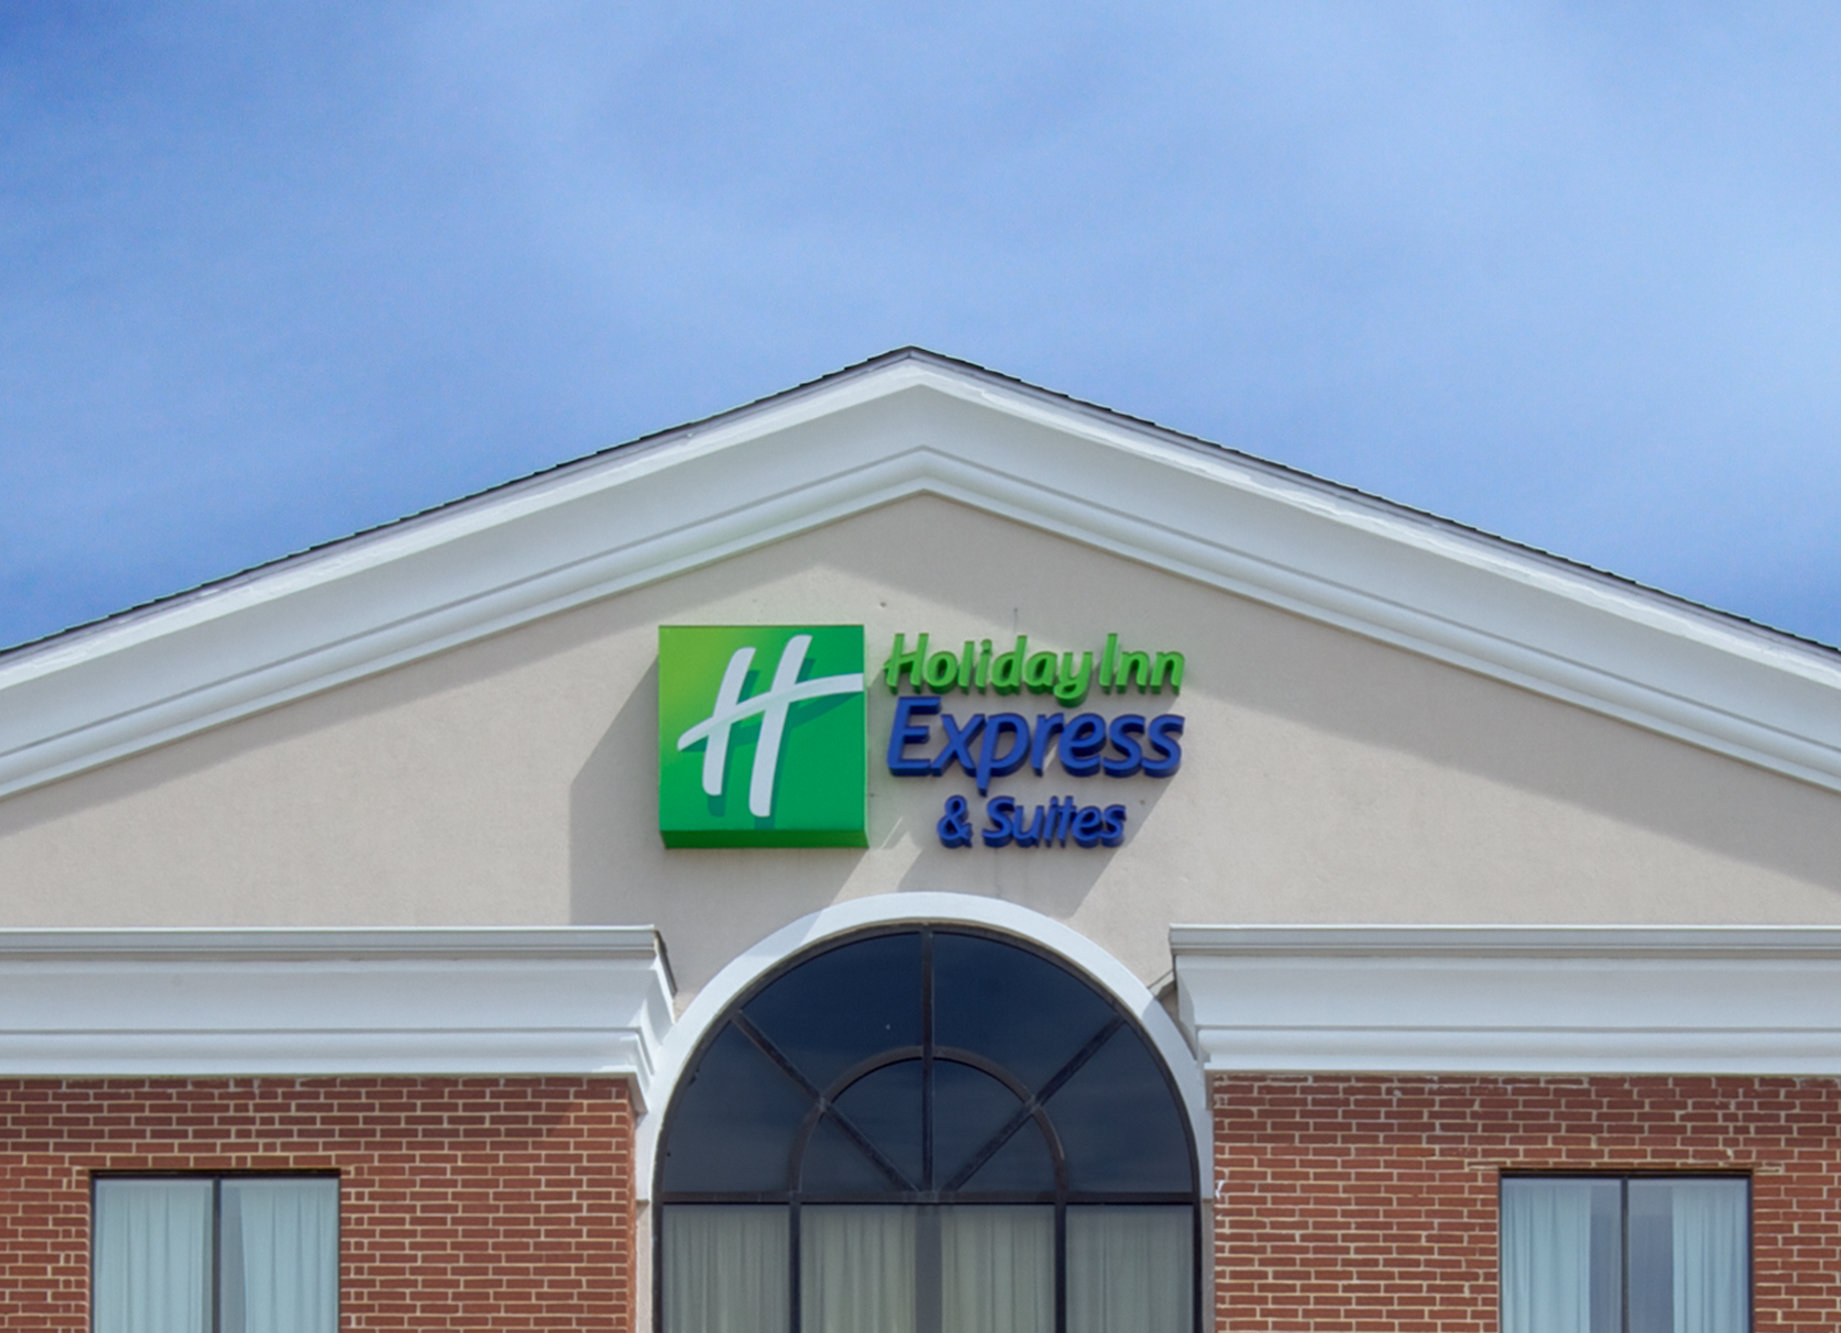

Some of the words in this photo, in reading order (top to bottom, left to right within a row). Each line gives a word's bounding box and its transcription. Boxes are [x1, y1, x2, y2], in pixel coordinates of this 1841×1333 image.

[883, 632, 1092, 707] Holiday
[1098, 632, 1185, 696] Inn
[886, 694, 1185, 797] Express
[936, 795, 973, 849] &
[982, 795, 1126, 849] Suites
